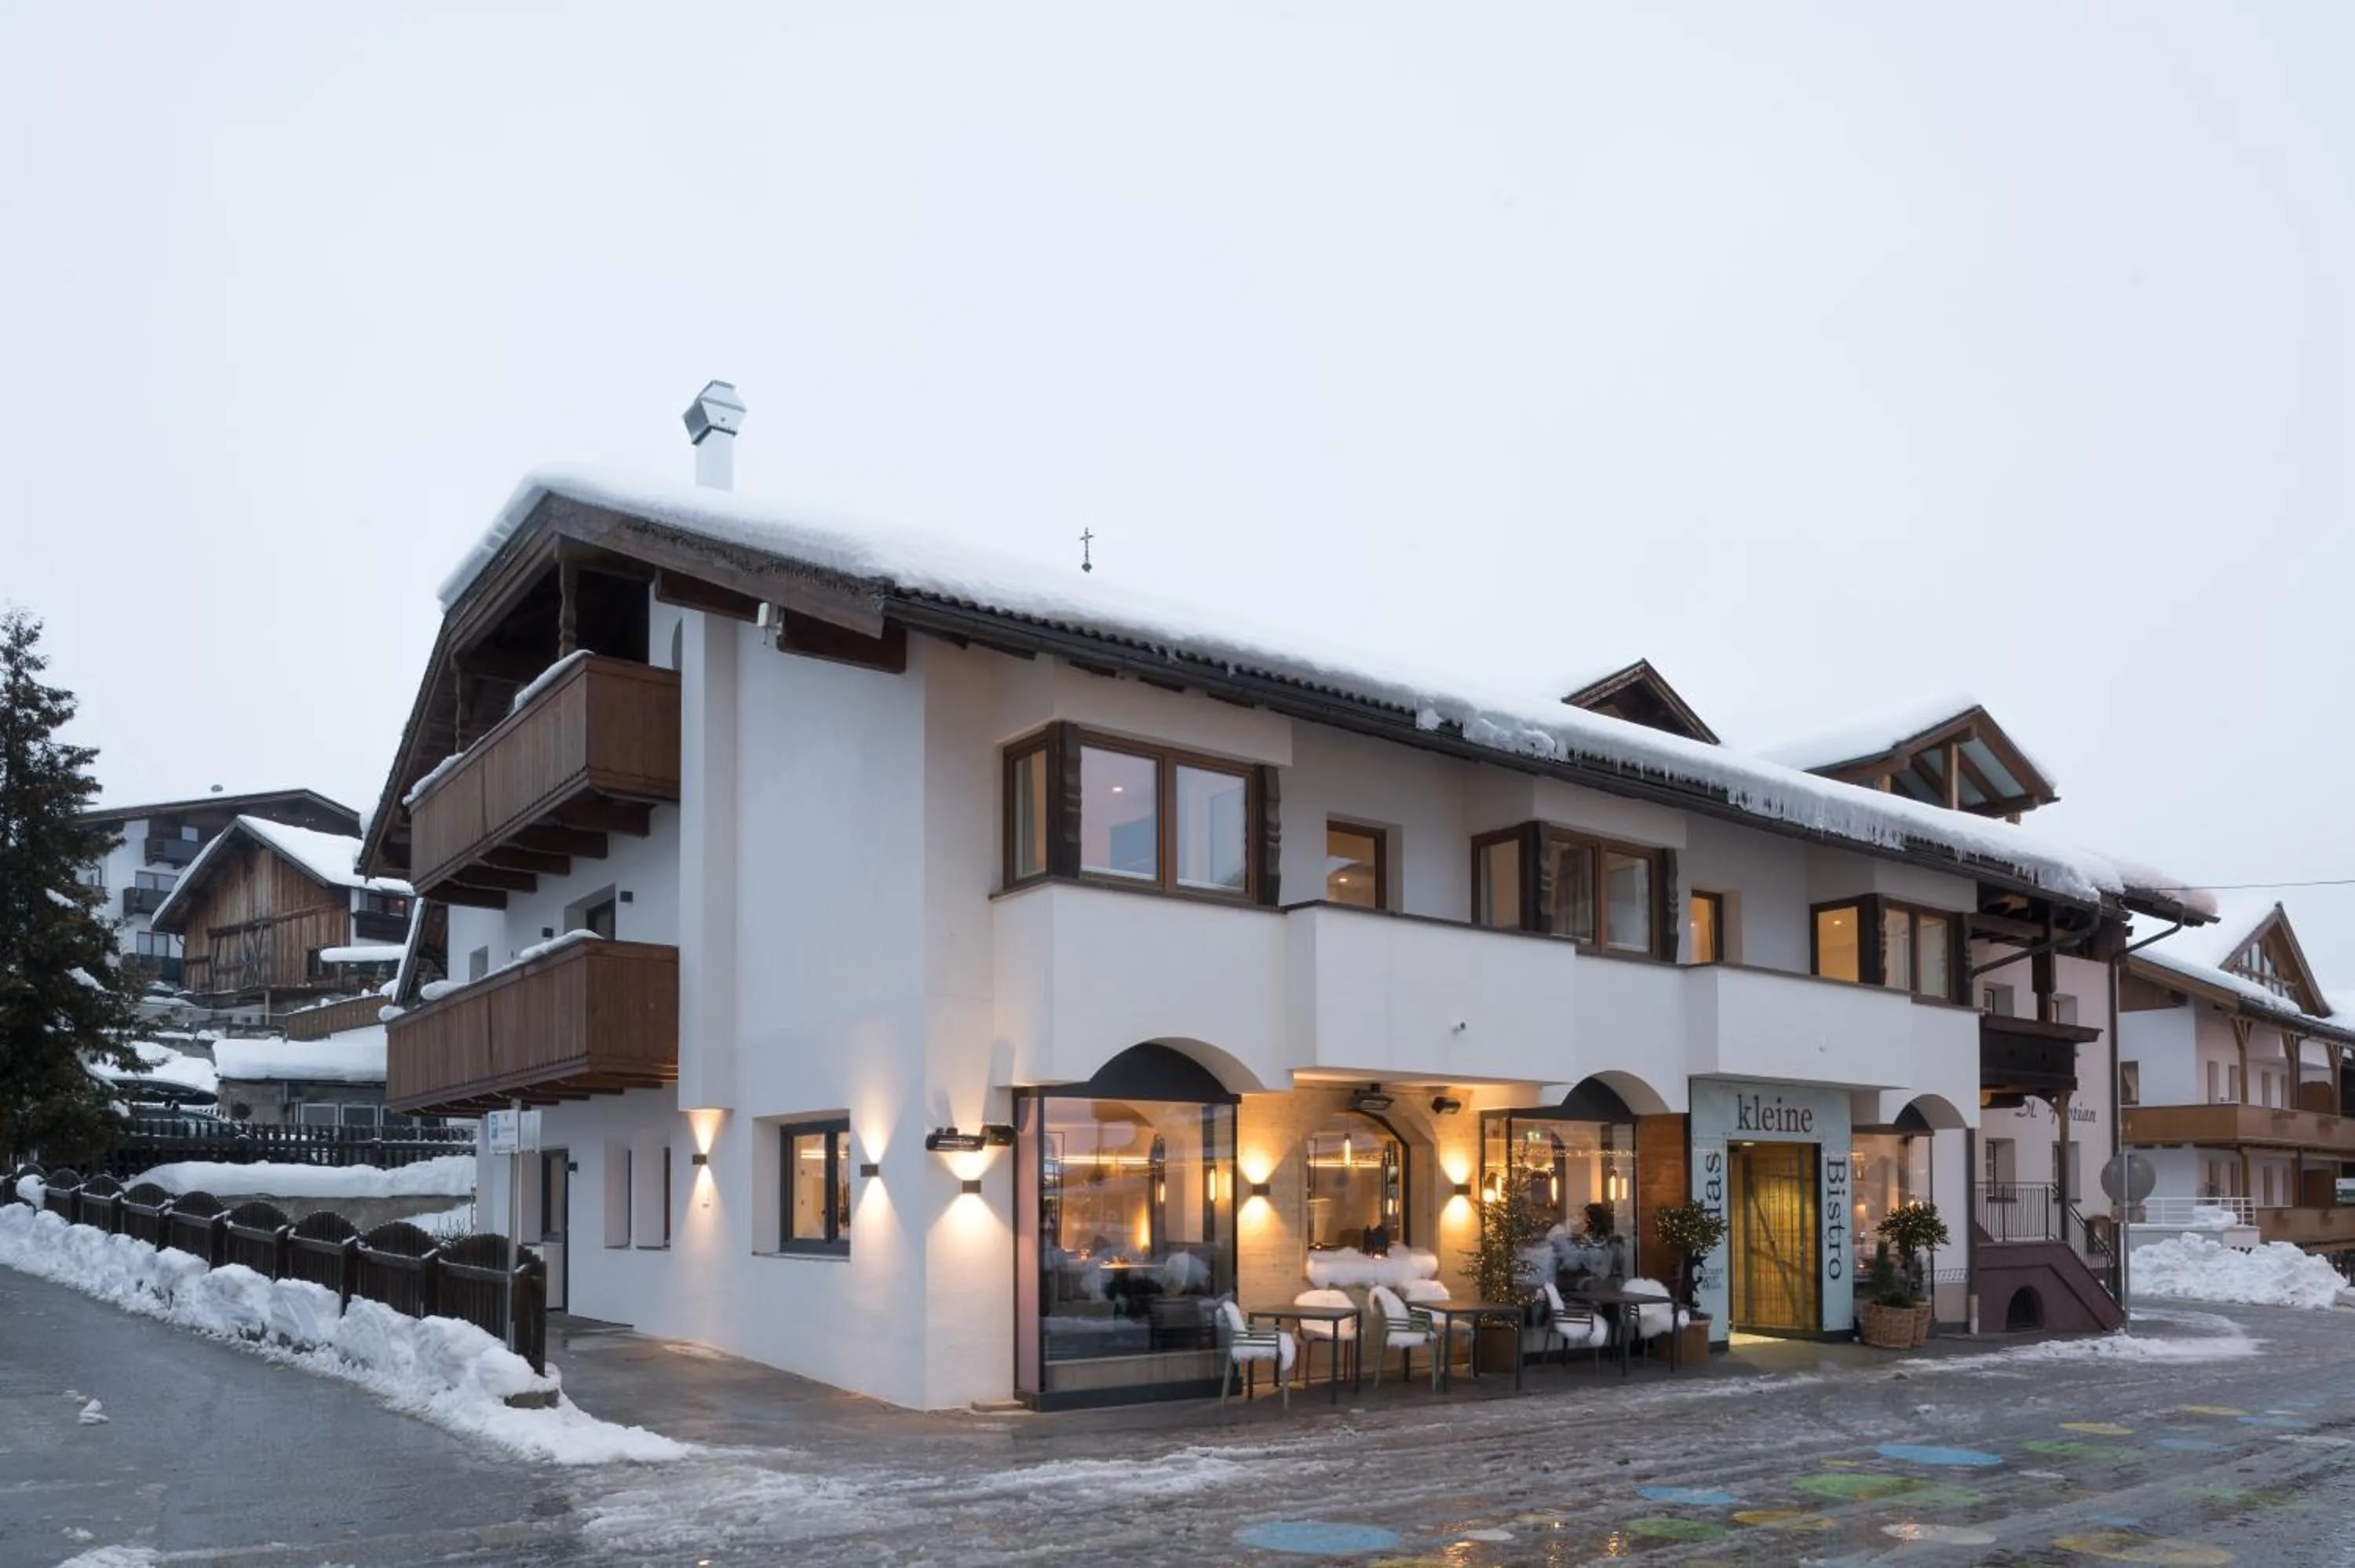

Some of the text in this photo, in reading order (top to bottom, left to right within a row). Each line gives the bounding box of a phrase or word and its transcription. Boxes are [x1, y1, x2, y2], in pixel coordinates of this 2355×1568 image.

[1736, 1093, 1813, 1132] kleine
[2047, 1101, 2097, 1125] rian
[1827, 1156, 1846, 1280] Bistro
